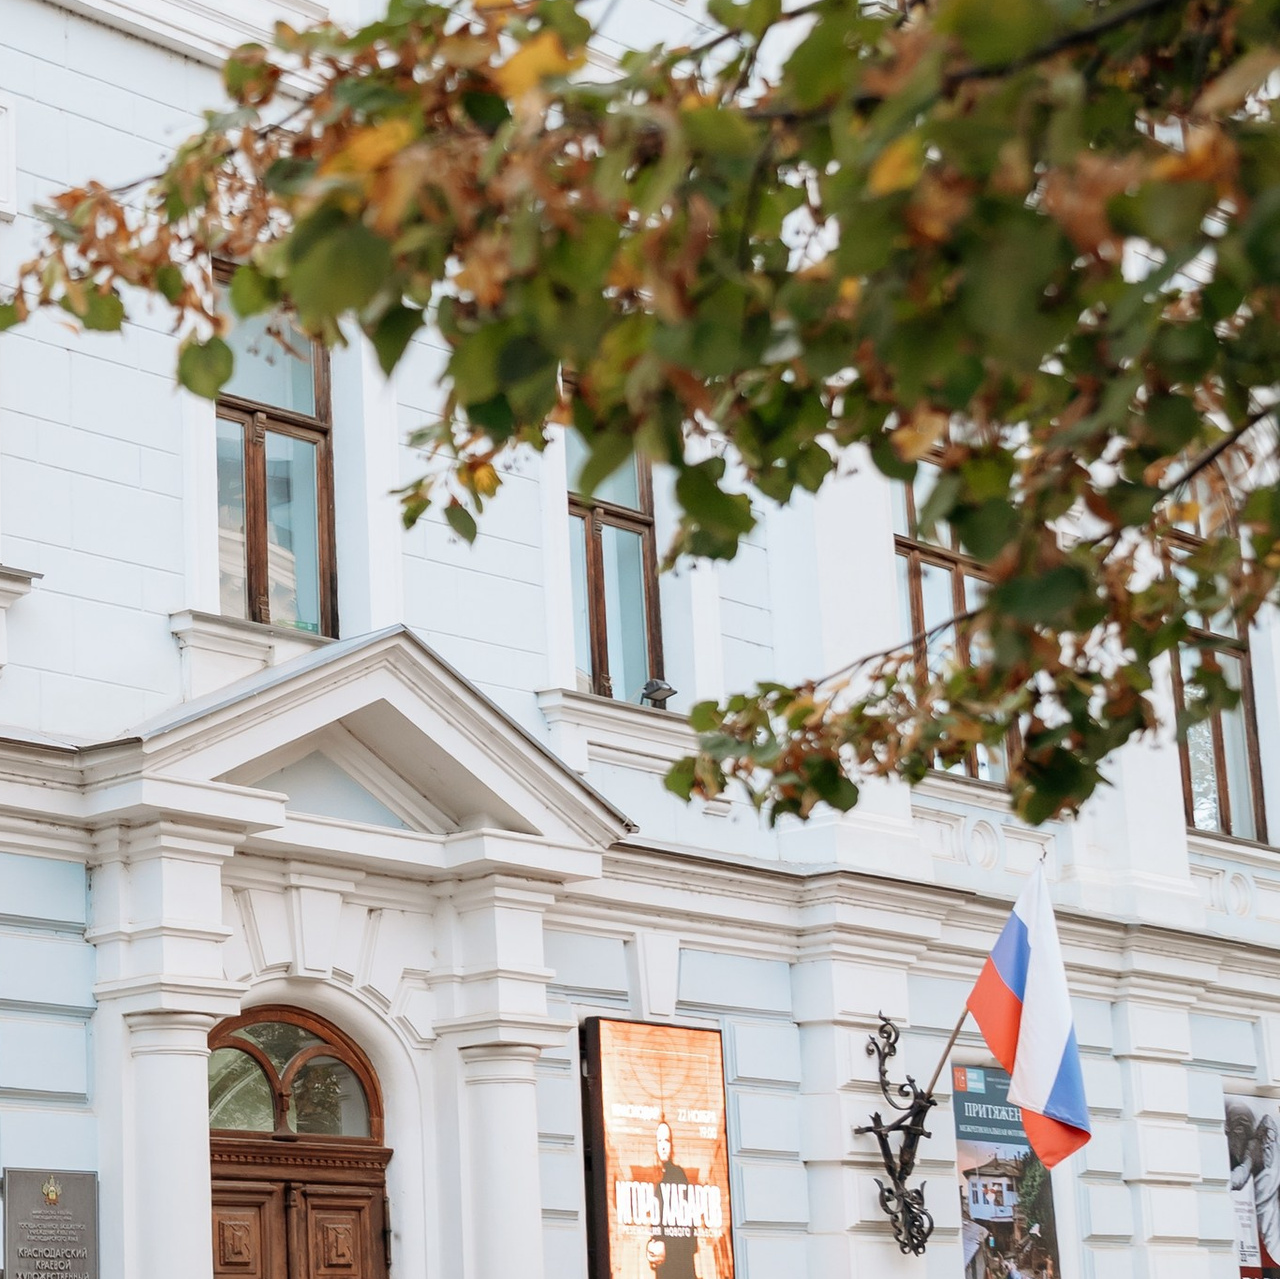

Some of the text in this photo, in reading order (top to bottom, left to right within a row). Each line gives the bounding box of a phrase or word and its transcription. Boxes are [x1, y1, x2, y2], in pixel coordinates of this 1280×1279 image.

[616, 1180, 722, 1228] ИГОРЬ ХАБАРОВ
[664, 1227, 691, 1237] НОВОГО
[18, 1247, 88, 1259] КРАСНОДАРСКИЙ
[35, 1260, 72, 1271] КРАЕВОЙ
